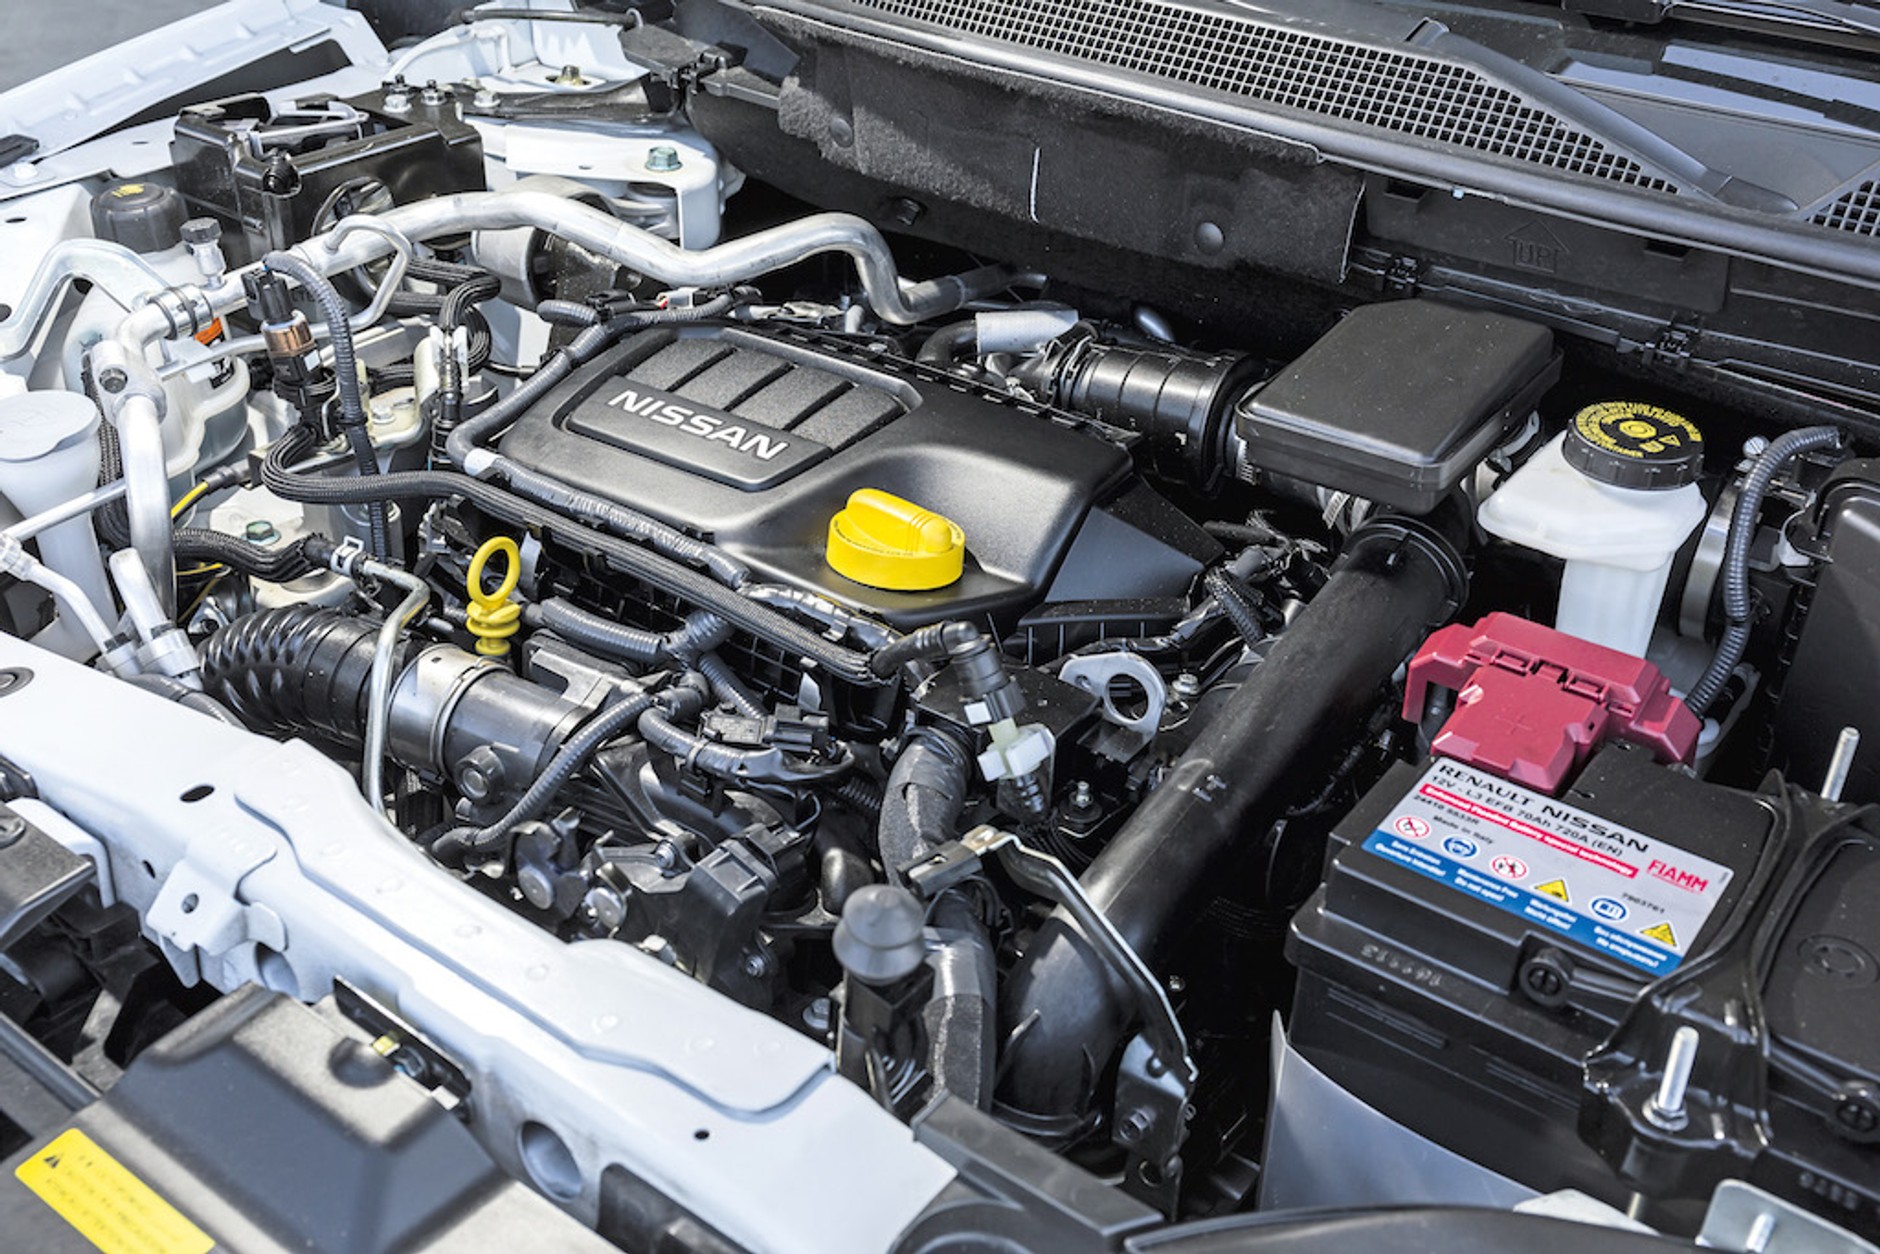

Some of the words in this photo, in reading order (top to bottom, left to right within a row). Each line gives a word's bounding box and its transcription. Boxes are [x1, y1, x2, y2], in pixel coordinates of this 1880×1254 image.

[608, 389, 788, 460] NISSAN
[1430, 776, 1455, 788] 12V
[1466, 789, 1483, 799] L3
[1485, 797, 1514, 812] EFB
[1517, 809, 1553, 827] 70Ah
[1555, 824, 1591, 842] 720A
[1592, 839, 1624, 857] (EN)
[1438, 765, 1535, 807] RENAULT
[1541, 805, 1649, 852] NISSAN
[1647, 860, 1709, 892] FIAMM
